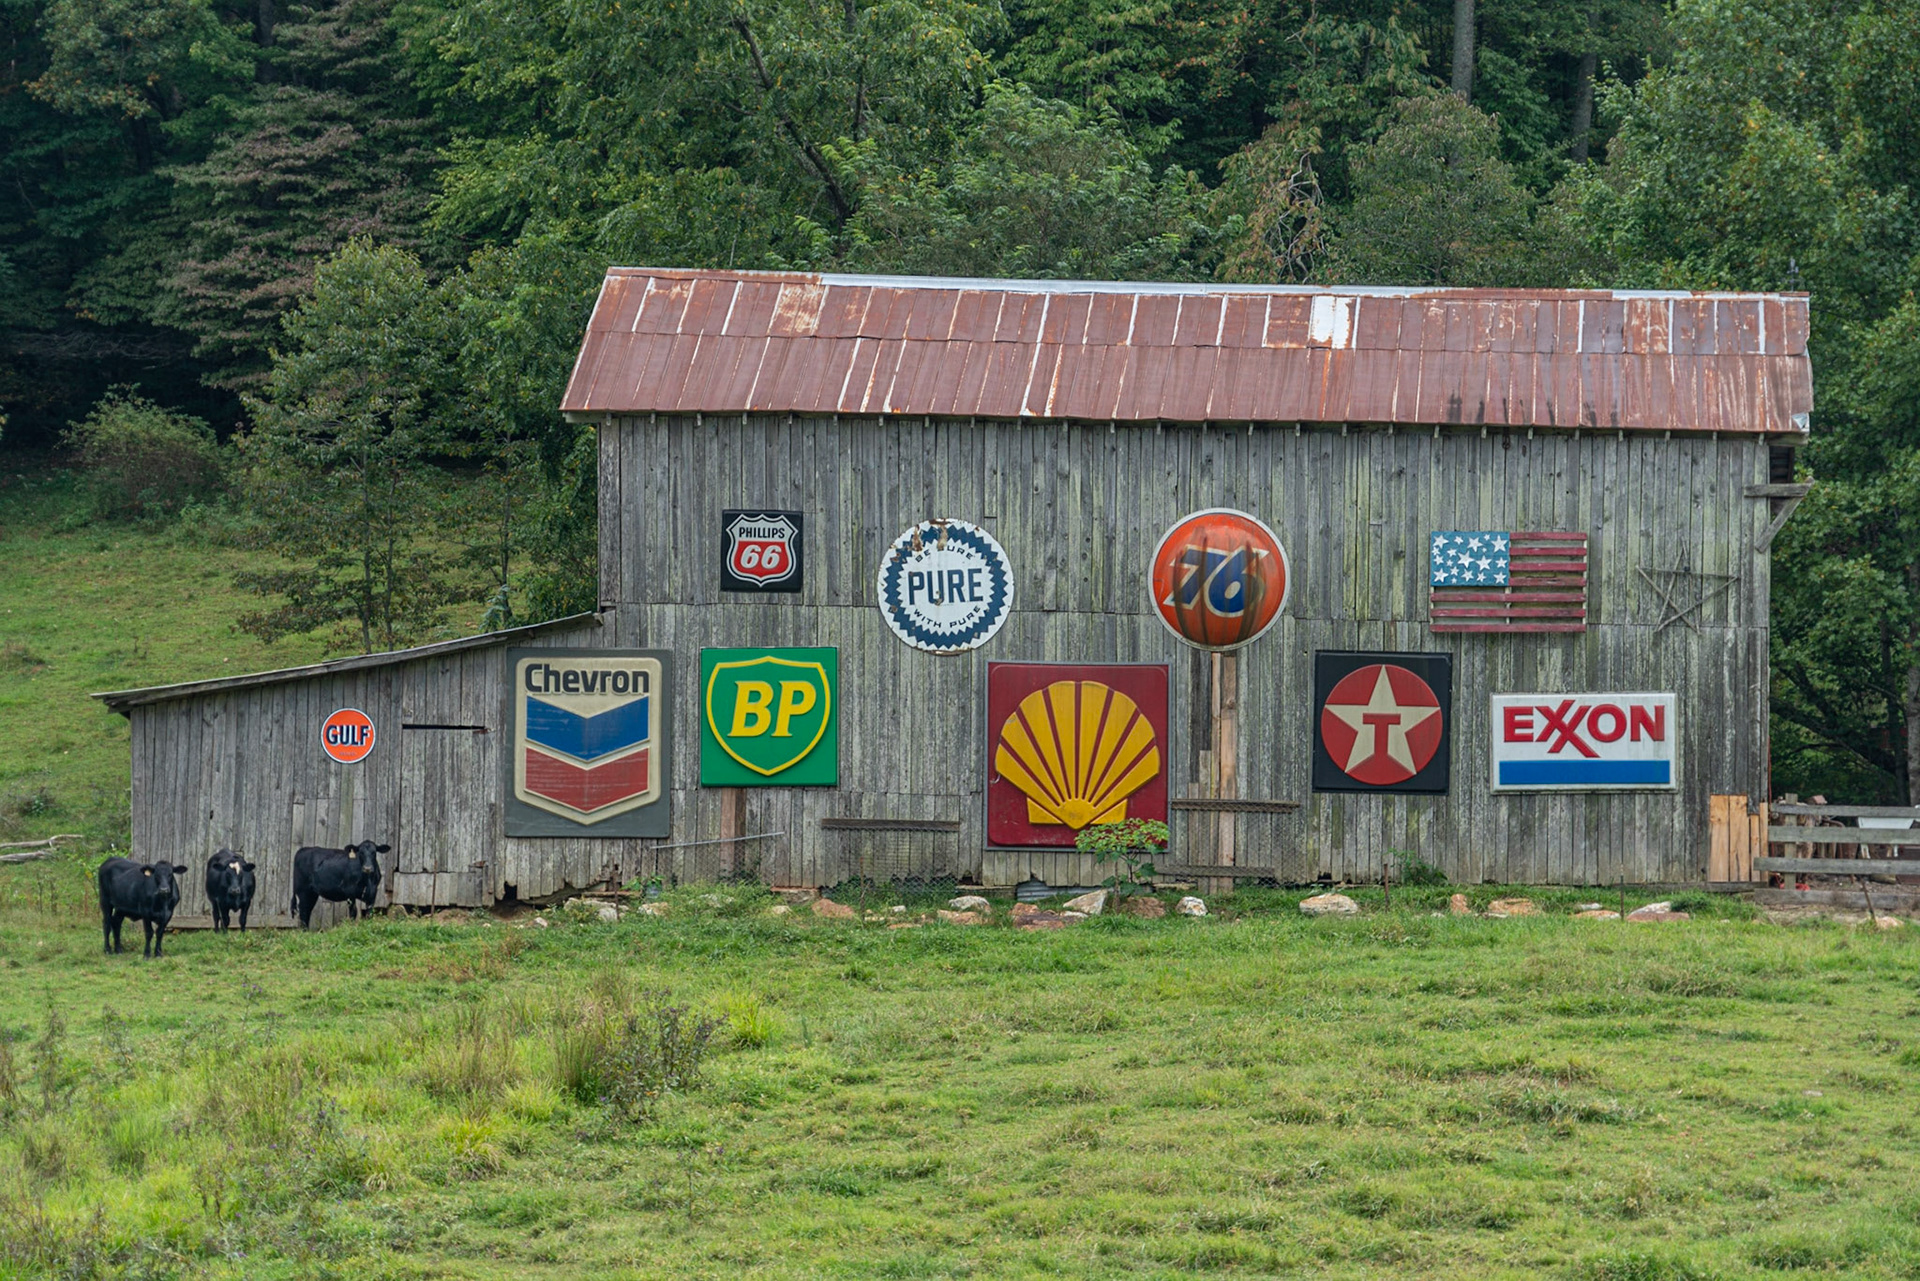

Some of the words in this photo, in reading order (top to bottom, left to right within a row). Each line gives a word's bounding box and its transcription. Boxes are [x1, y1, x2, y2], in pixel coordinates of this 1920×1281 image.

[738, 526, 785, 539] PHILLIPS
[740, 544, 782, 569] 66
[915, 549, 931, 563] BE
[937, 543, 974, 560] URE
[908, 568, 984, 606] PURE
[1163, 544, 1269, 618] 76
[914, 609, 942, 628] WITH
[949, 605, 981, 628] PURE
[525, 663, 650, 694] Chevron
[727, 681, 817, 737] BP
[326, 724, 371, 746] GULF
[1362, 713, 1401, 761] T
[1503, 699, 1665, 758] EXXON
